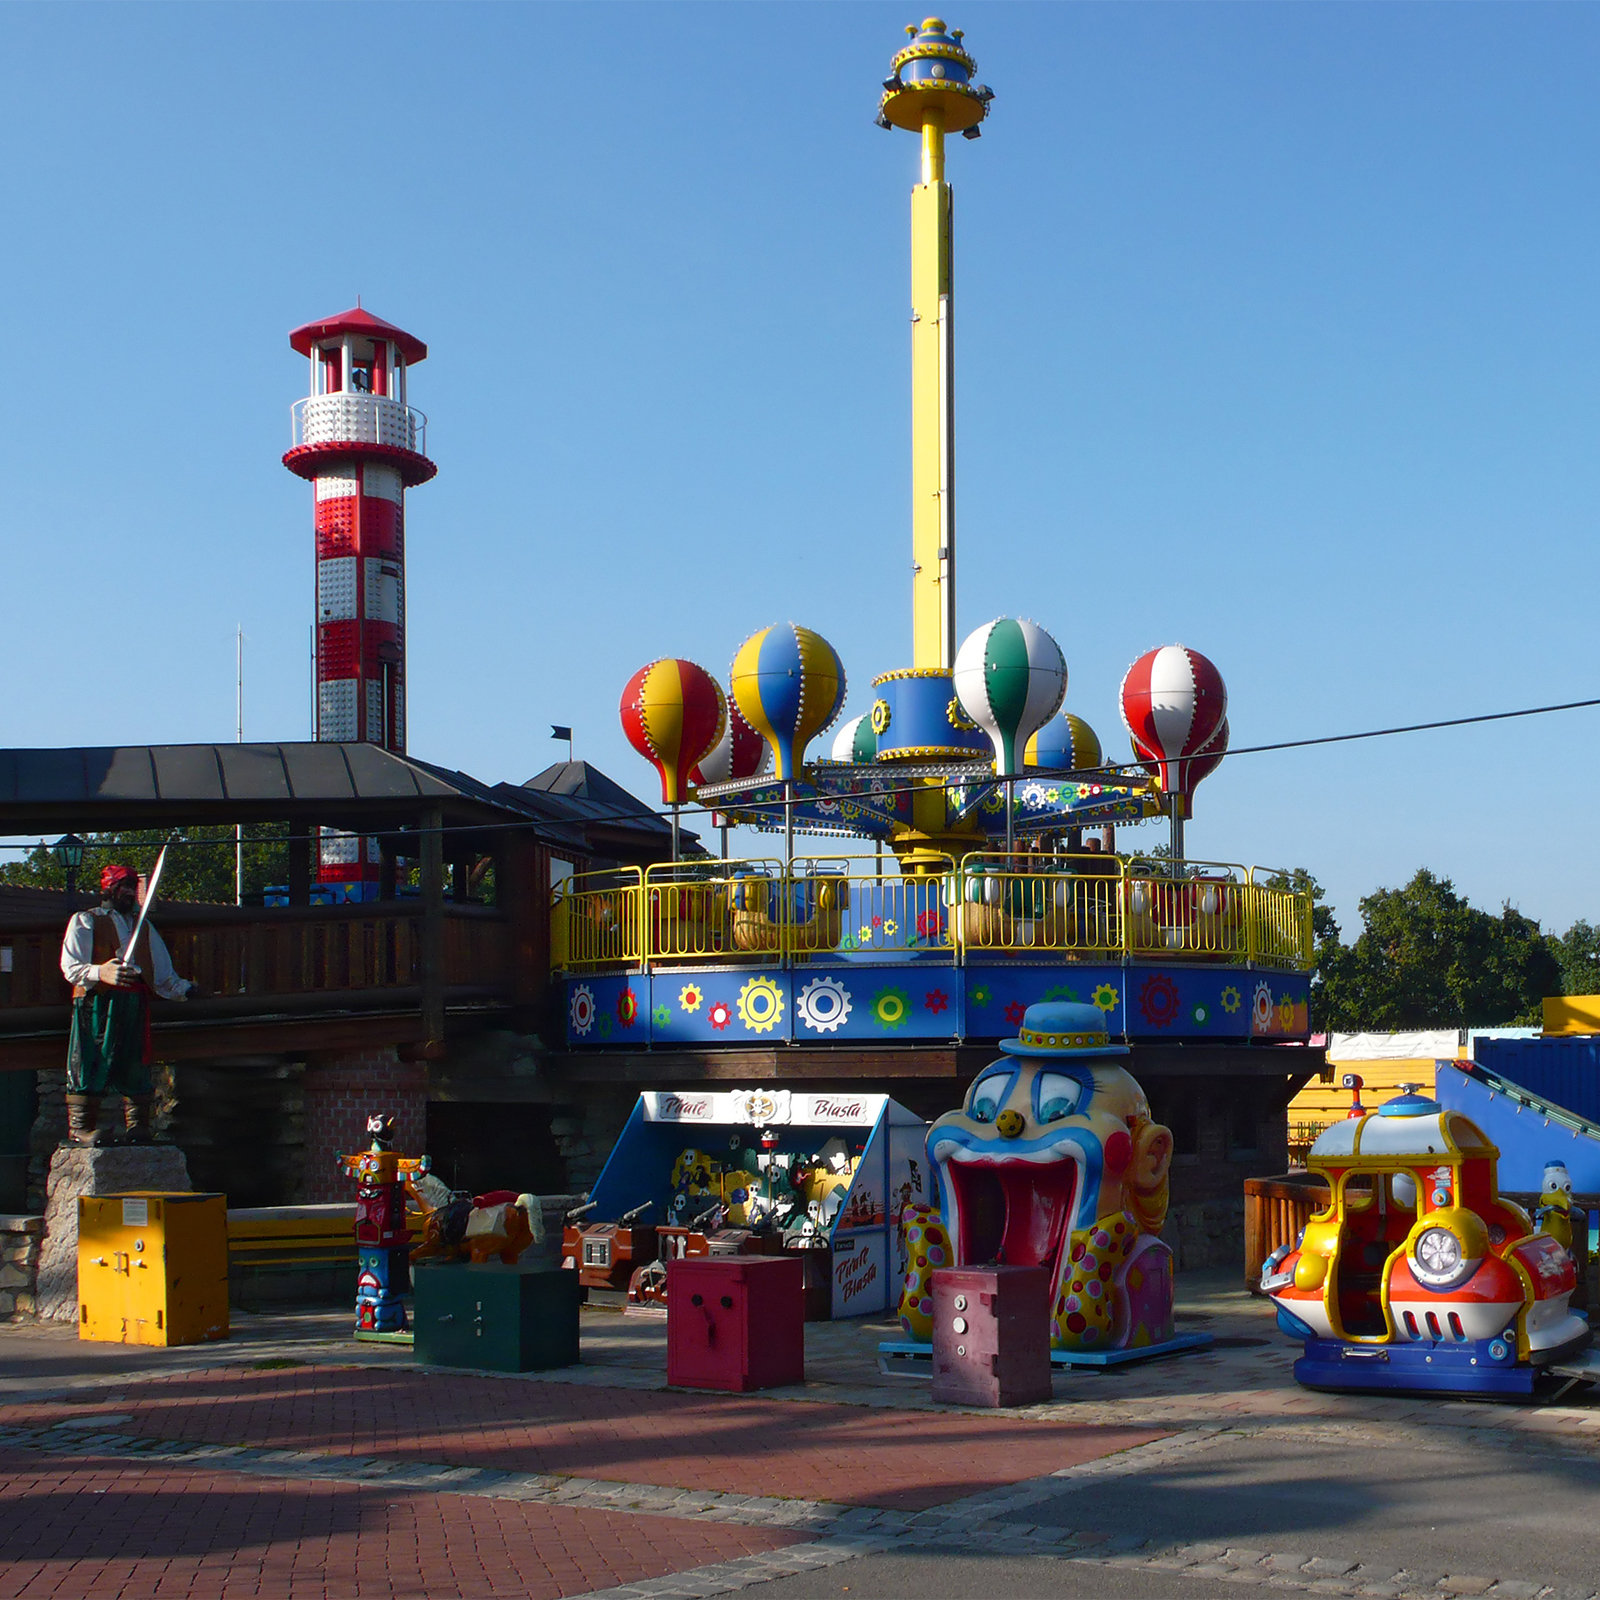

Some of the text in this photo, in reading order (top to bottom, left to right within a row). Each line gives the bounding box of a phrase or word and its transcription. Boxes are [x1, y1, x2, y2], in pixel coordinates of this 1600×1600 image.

[665, 1097, 861, 1117] Pirate Blasta
[835, 1246, 869, 1284] Pirate
[842, 1263, 877, 1303] Blasta
